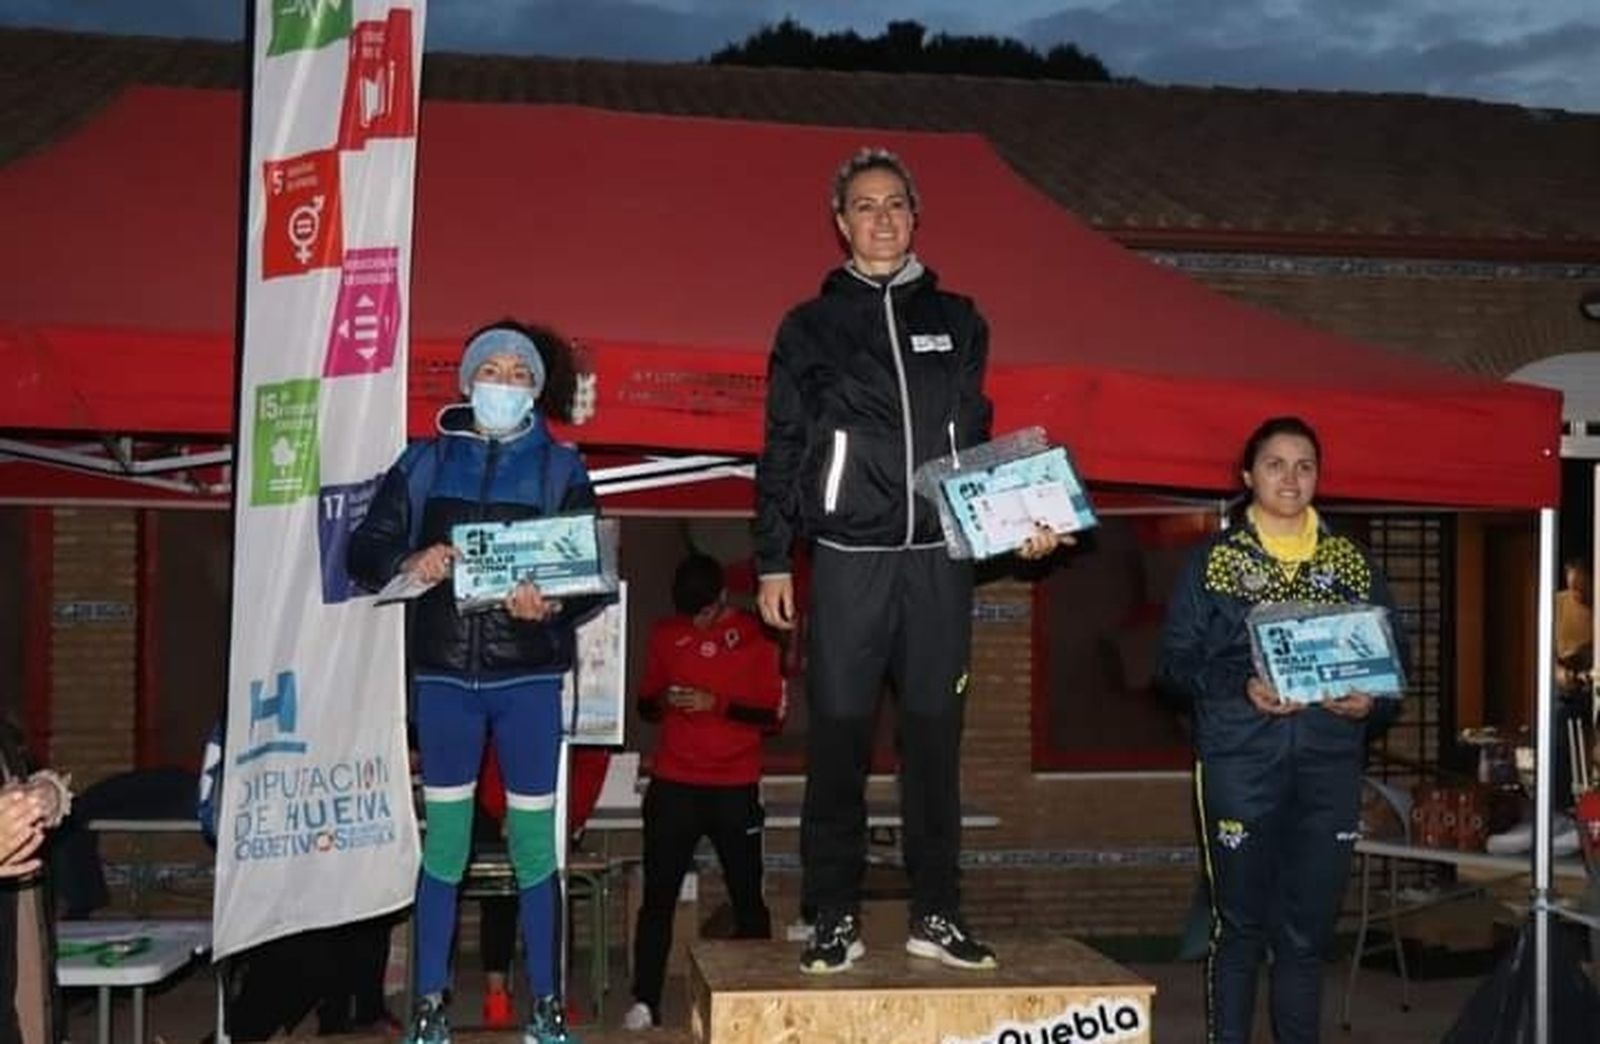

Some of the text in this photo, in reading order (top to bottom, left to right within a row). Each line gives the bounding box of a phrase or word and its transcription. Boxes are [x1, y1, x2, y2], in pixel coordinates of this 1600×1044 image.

[271, 169, 284, 196] 5
[259, 393, 278, 420] 15
[323, 493, 345, 520] 17
[234, 804, 271, 841] DE
